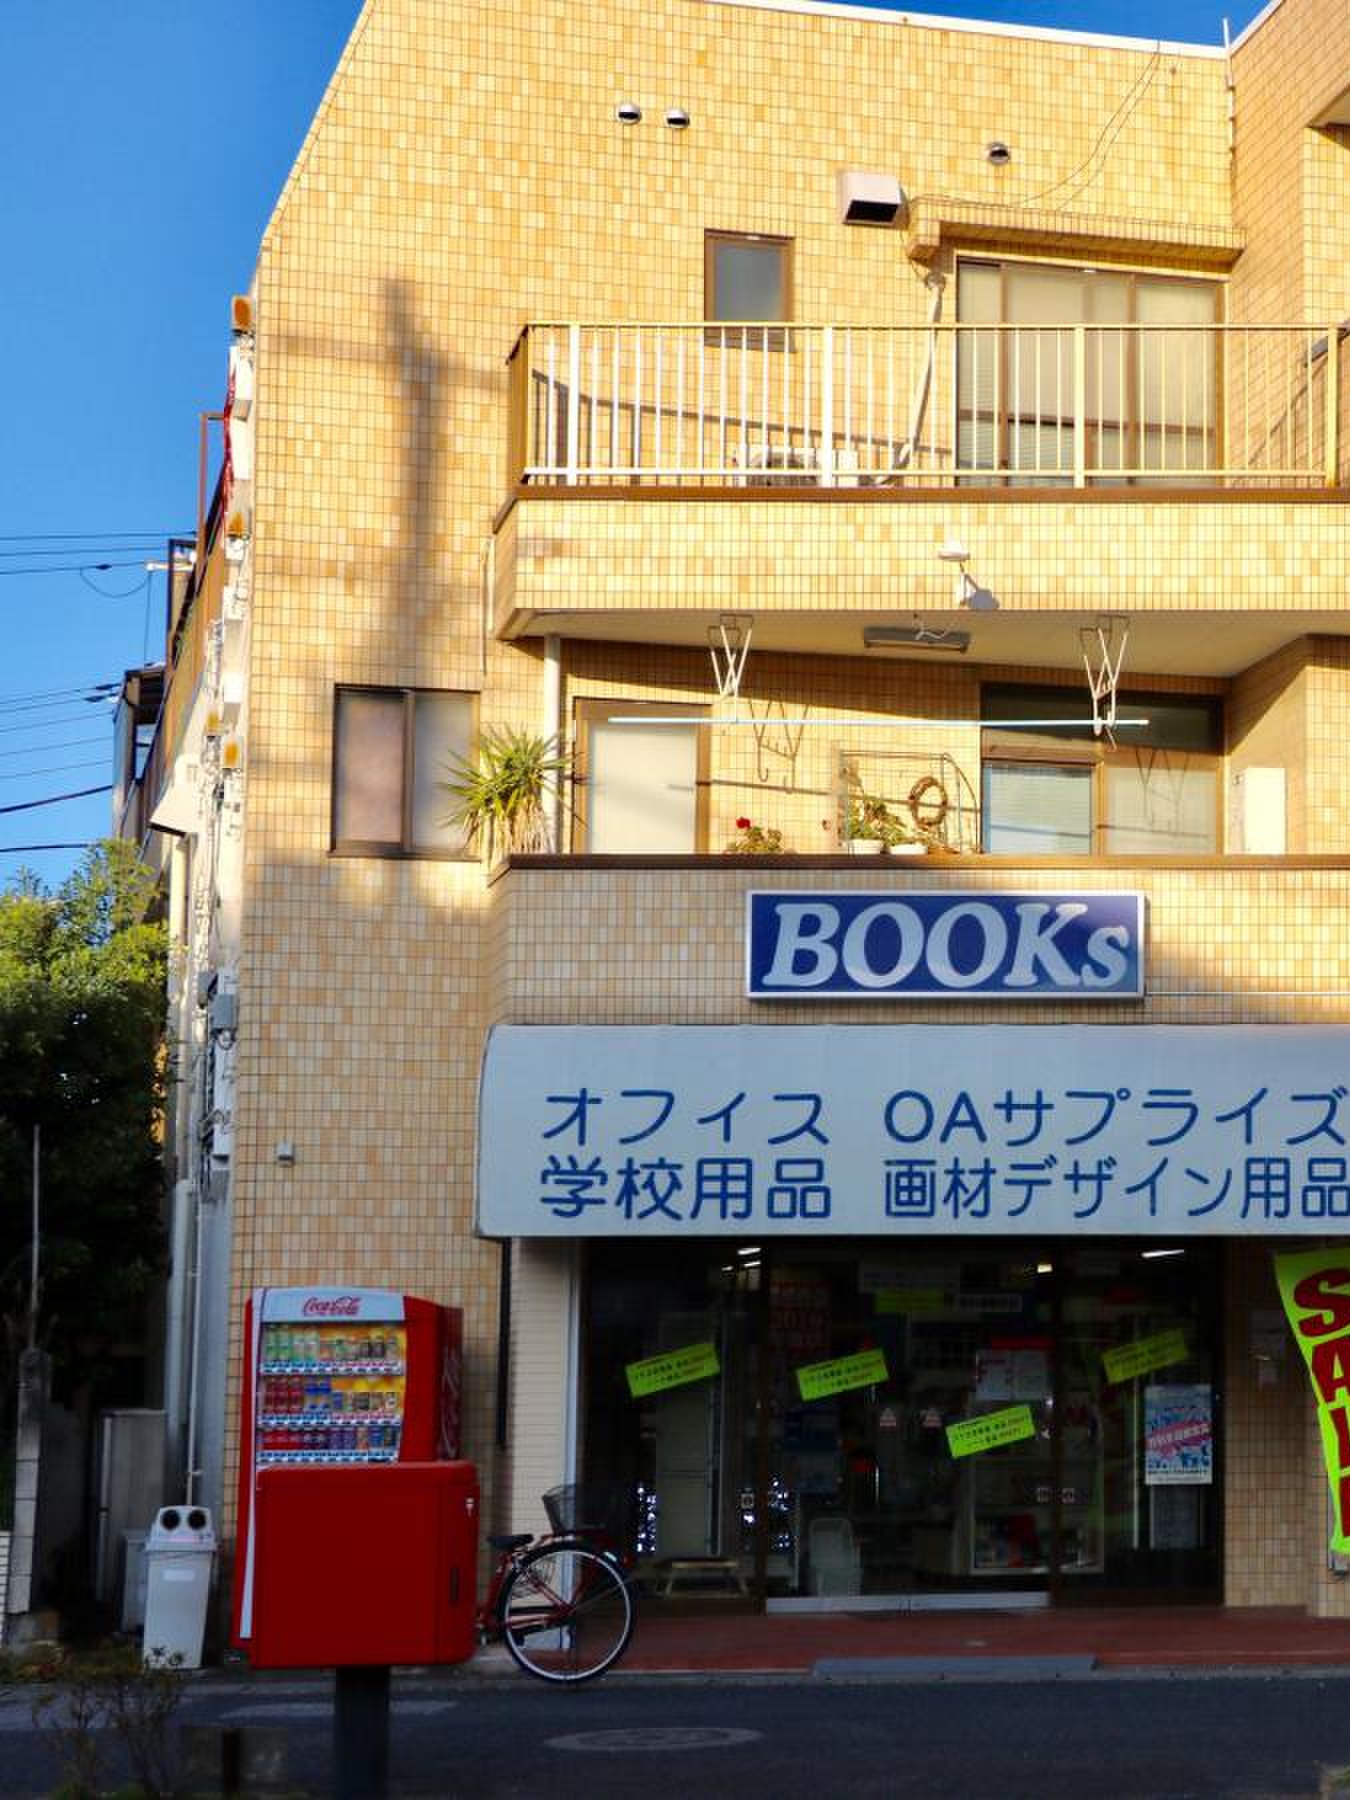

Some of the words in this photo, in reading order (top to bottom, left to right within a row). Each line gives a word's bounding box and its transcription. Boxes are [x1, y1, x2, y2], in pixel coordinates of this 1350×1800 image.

[762, 902, 1130, 988] BOOKs
[541, 1087, 831, 1147] オフィス
[884, 1085, 1350, 1147] OAサプライズ
[539, 1154, 832, 1221] 学校用品
